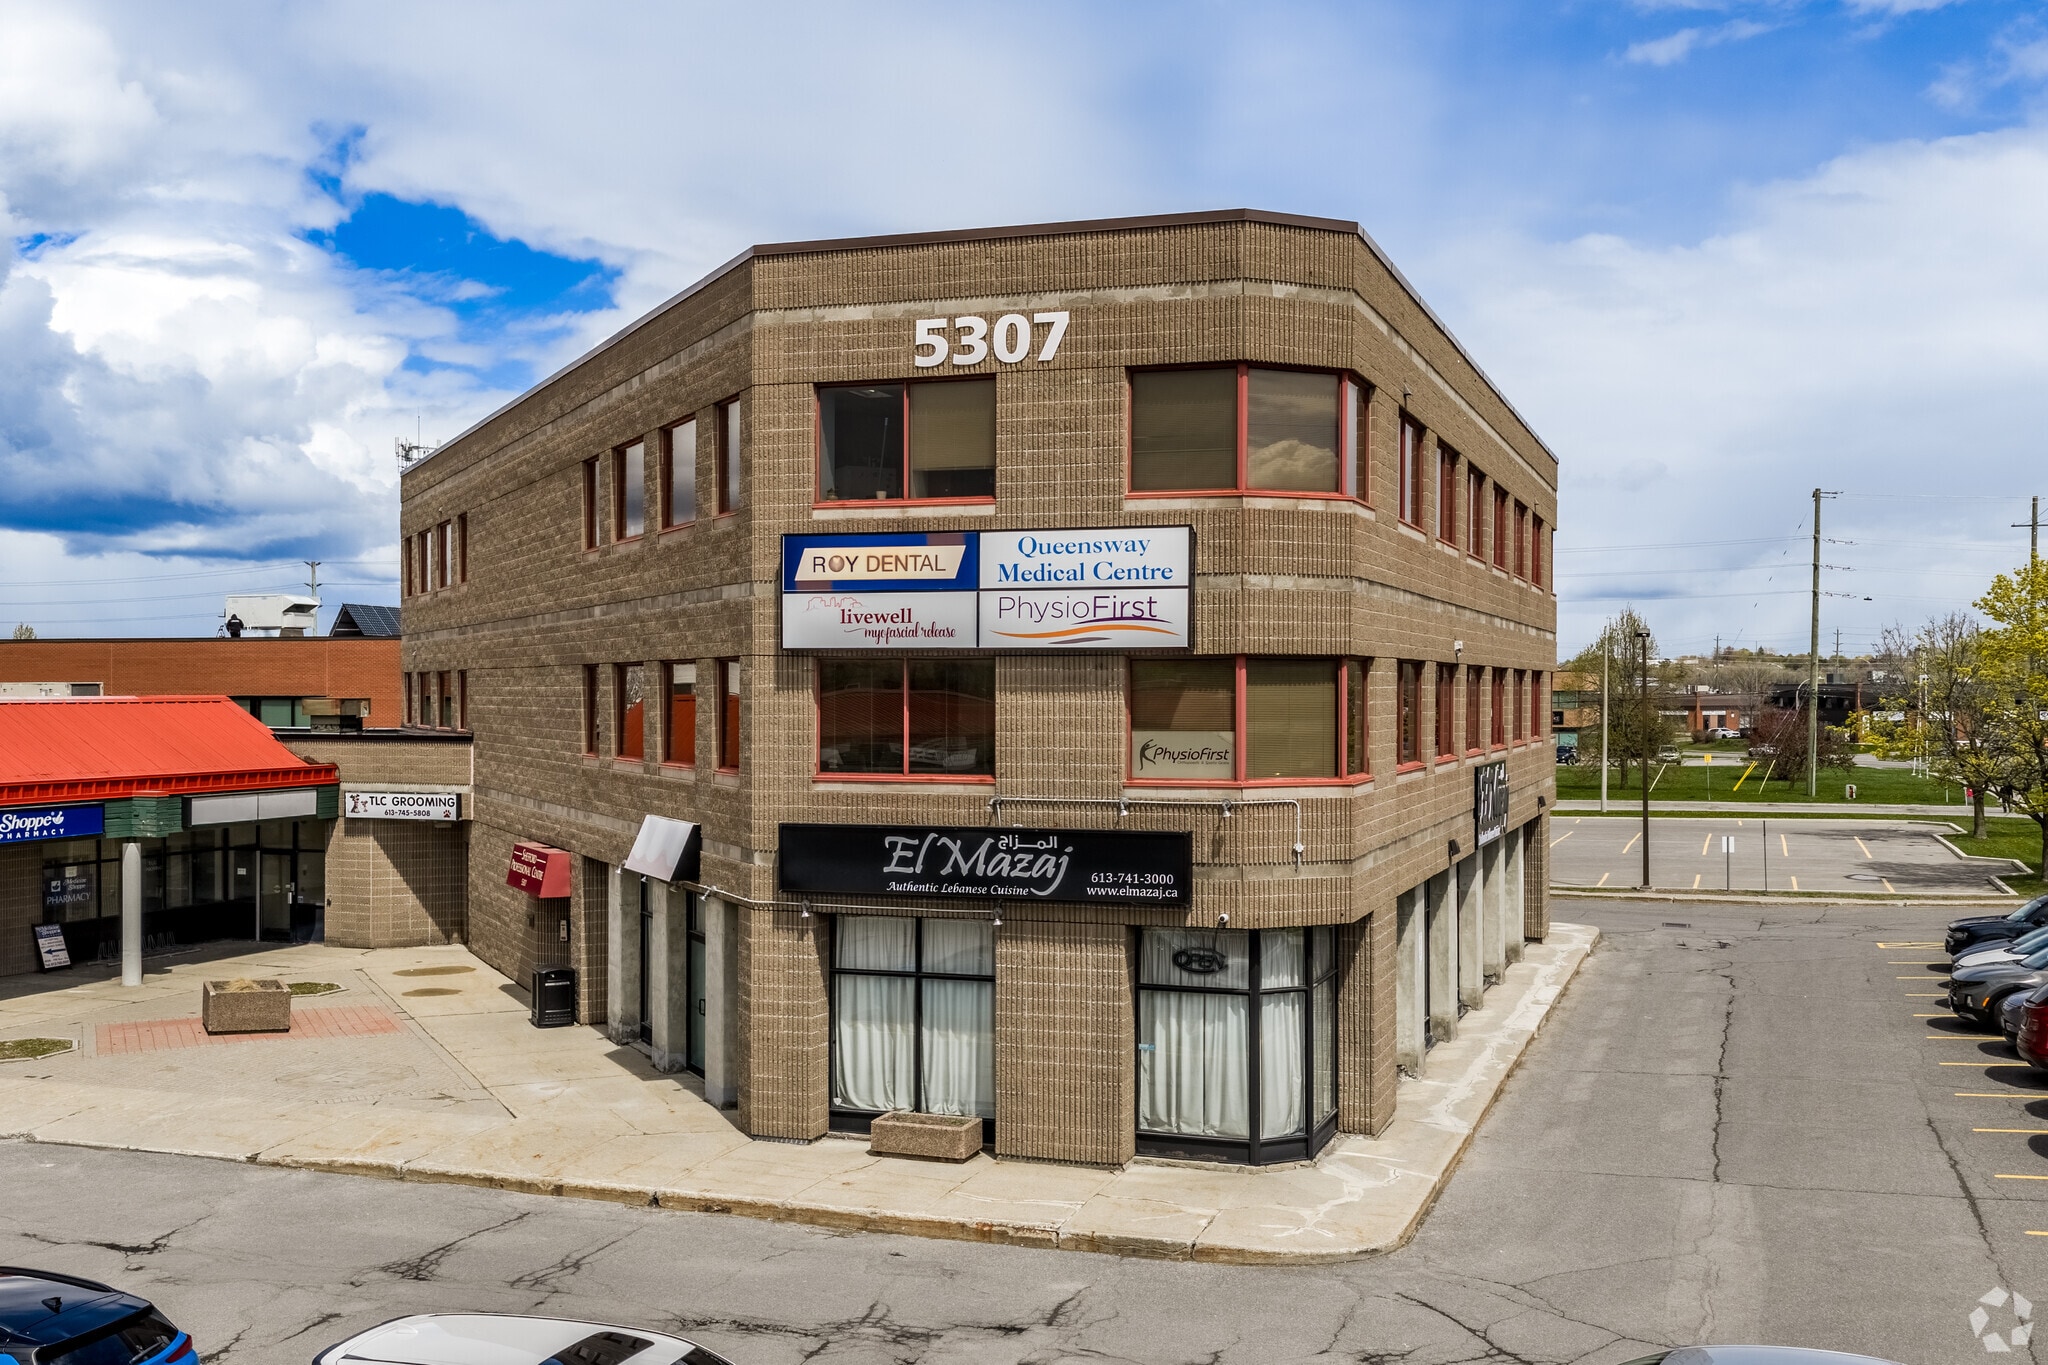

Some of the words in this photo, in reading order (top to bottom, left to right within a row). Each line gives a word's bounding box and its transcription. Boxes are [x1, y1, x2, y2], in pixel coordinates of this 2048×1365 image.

[915, 311, 1070, 367] 5307
[1018, 536, 1151, 558] Queensway
[813, 555, 859, 573] ROY
[866, 554, 946, 572] DENTAL
[998, 562, 1085, 582] Medical
[1093, 561, 1173, 580] Centre
[840, 608, 912, 624] livewell
[999, 595, 1158, 623] PhysioFirst
[864, 622, 920, 645] myofascial
[921, 621, 957, 638] release
[1153, 747, 1230, 763] PhysioFirst
[369, 796, 387, 806] TLC
[392, 797, 455, 807] GROOMING
[384, 809, 431, 817] 613-745-5808
[0, 813, 52, 832] Shoppe
[883, 832, 938, 874] El
[937, 837, 1074, 896] Mazaj
[1091, 872, 1174, 885] 613-741-3000
[886, 881, 939, 893] Authentic
[941, 883, 988, 895] Lebanese
[990, 885, 1029, 896] Cuisine
[1086, 885, 1178, 900] www.elmazaj.ca
[47, 892, 90, 904] PHARMACY
